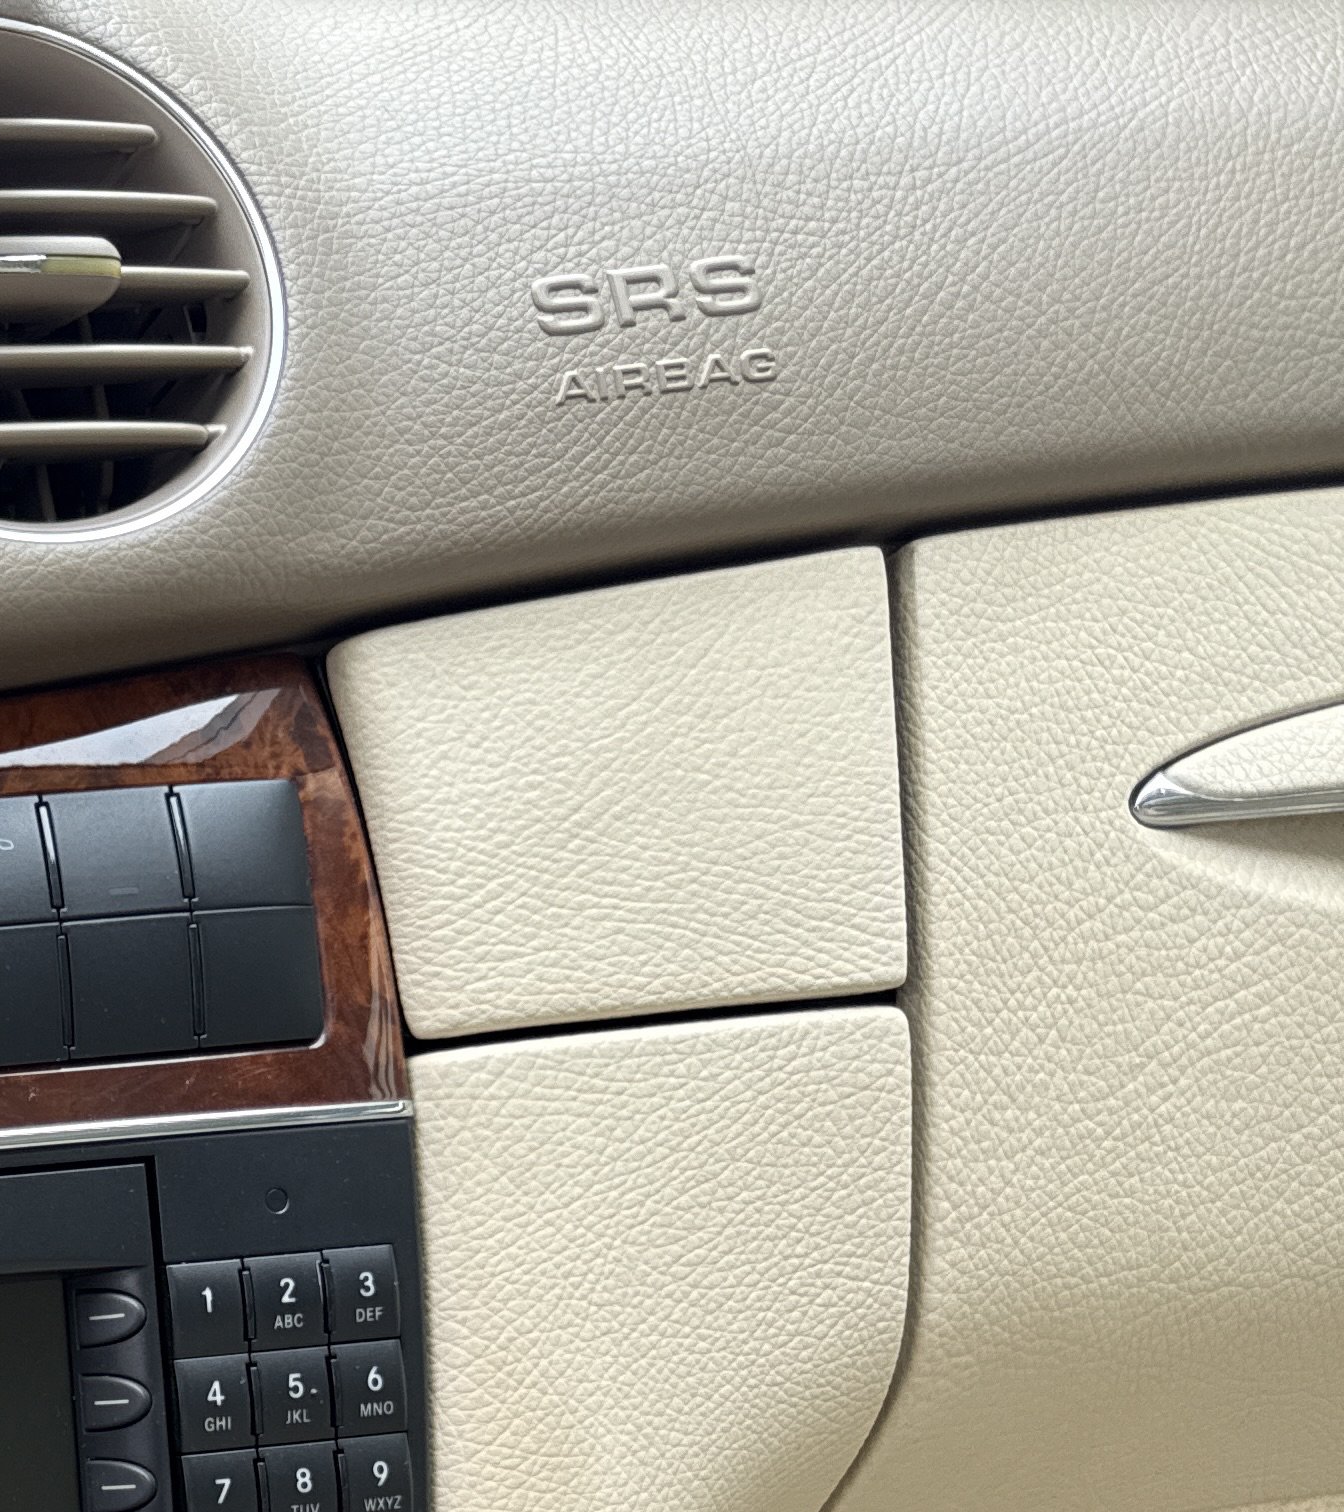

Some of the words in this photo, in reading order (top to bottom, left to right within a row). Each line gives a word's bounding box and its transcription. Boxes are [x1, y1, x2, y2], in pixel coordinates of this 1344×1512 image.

[531, 255, 762, 336] SRS
[556, 347, 777, 405] AIRBAG
[279, 1277, 297, 1304] 2
[358, 1271, 376, 1298] 3
[201, 1286, 214, 1313] 1
[273, 1313, 304, 1330] ABC
[355, 1307, 384, 1323] DEF
[207, 1379, 225, 1407] 4
[287, 1372, 305, 1399] 5
[366, 1366, 384, 1393] 6
[285, 1409, 311, 1425] JKL
[359, 1400, 394, 1417] MNO
[204, 1416, 232, 1433] GHI
[295, 1467, 313, 1495] 8
[371, 1460, 389, 1487] 9
[215, 1477, 232, 1504] 7
[363, 1495, 402, 1512] WXYZ
